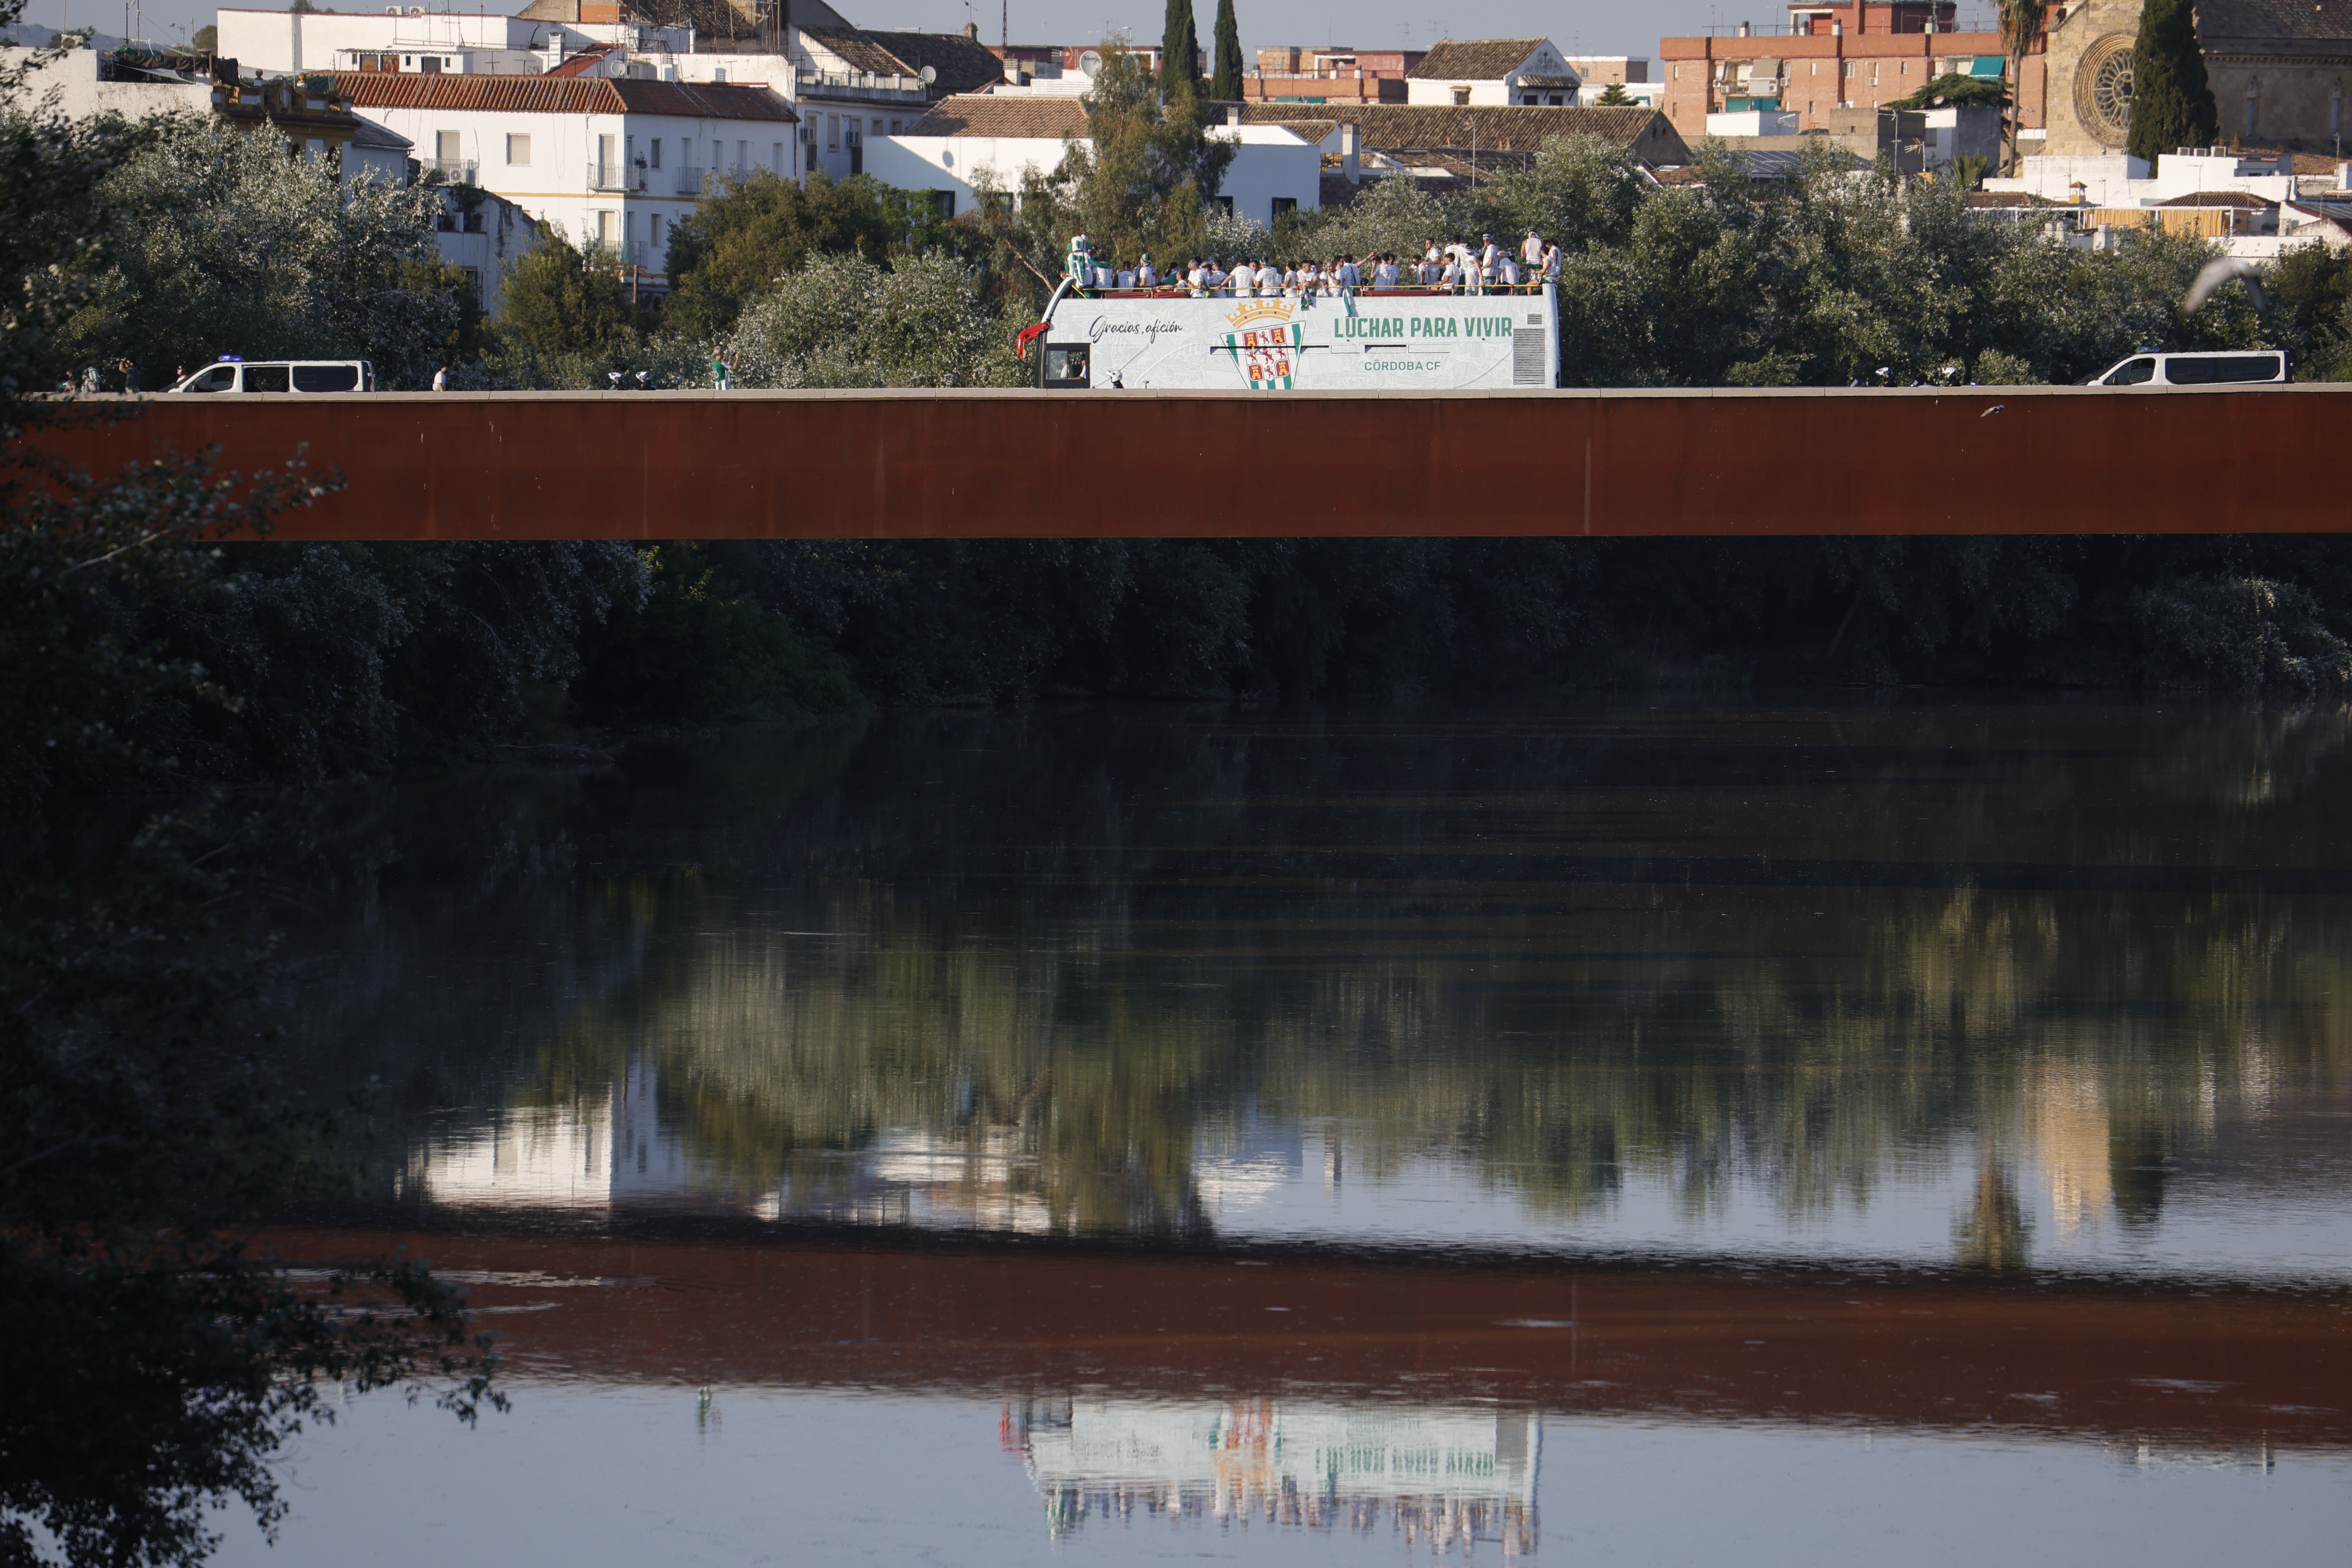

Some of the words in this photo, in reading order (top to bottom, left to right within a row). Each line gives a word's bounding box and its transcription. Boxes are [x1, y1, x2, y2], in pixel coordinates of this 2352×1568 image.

[1089, 315, 1144, 344] Gracias,
[1145, 319, 1183, 344] afición
[1334, 318, 1403, 338] LUCHAR
[1411, 318, 1457, 337] PARA
[1465, 317, 1512, 337] VIVIR
[1426, 361, 1441, 370] CF
